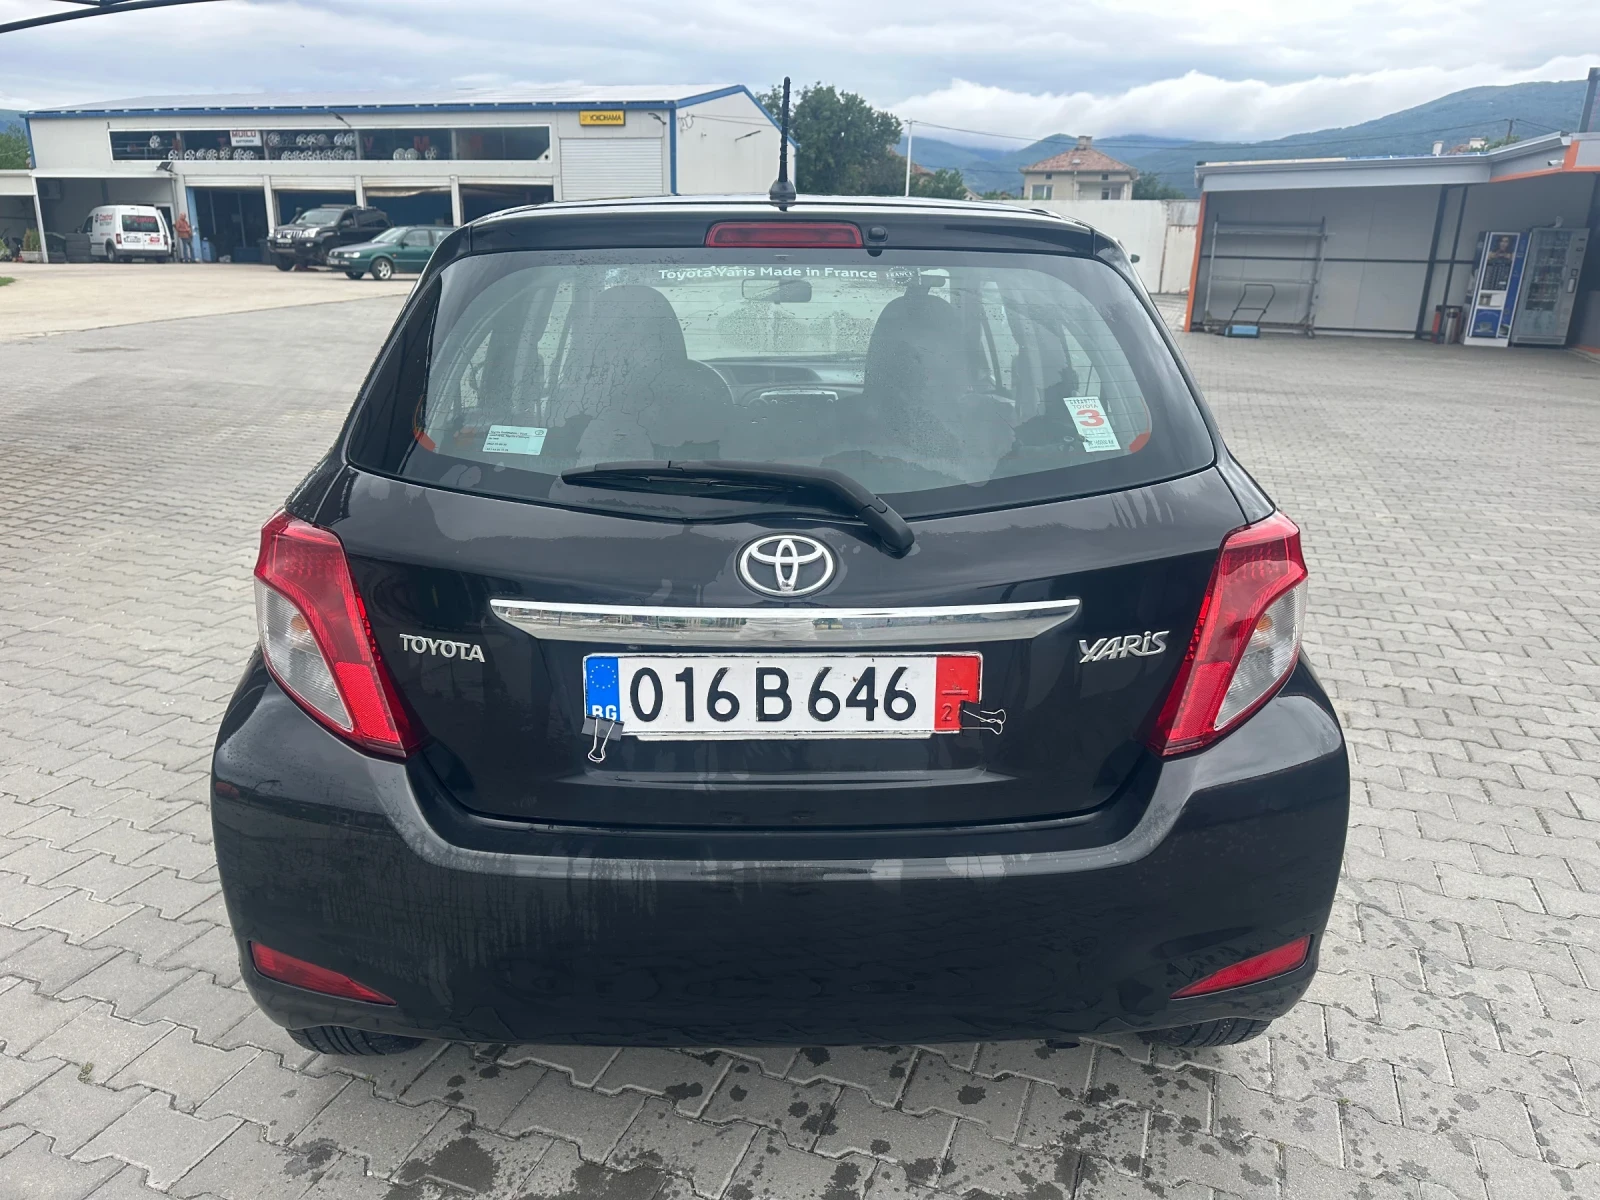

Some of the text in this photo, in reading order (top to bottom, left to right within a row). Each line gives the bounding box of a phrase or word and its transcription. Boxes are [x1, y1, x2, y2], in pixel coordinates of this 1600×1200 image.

[659, 266, 877, 280] Toyota Yaris Made in France
[1076, 409, 1105, 426] 3
[399, 633, 486, 663] TOYOTA
[629, 666, 917, 722] 016 B 646
[591, 704, 617, 721] BG
